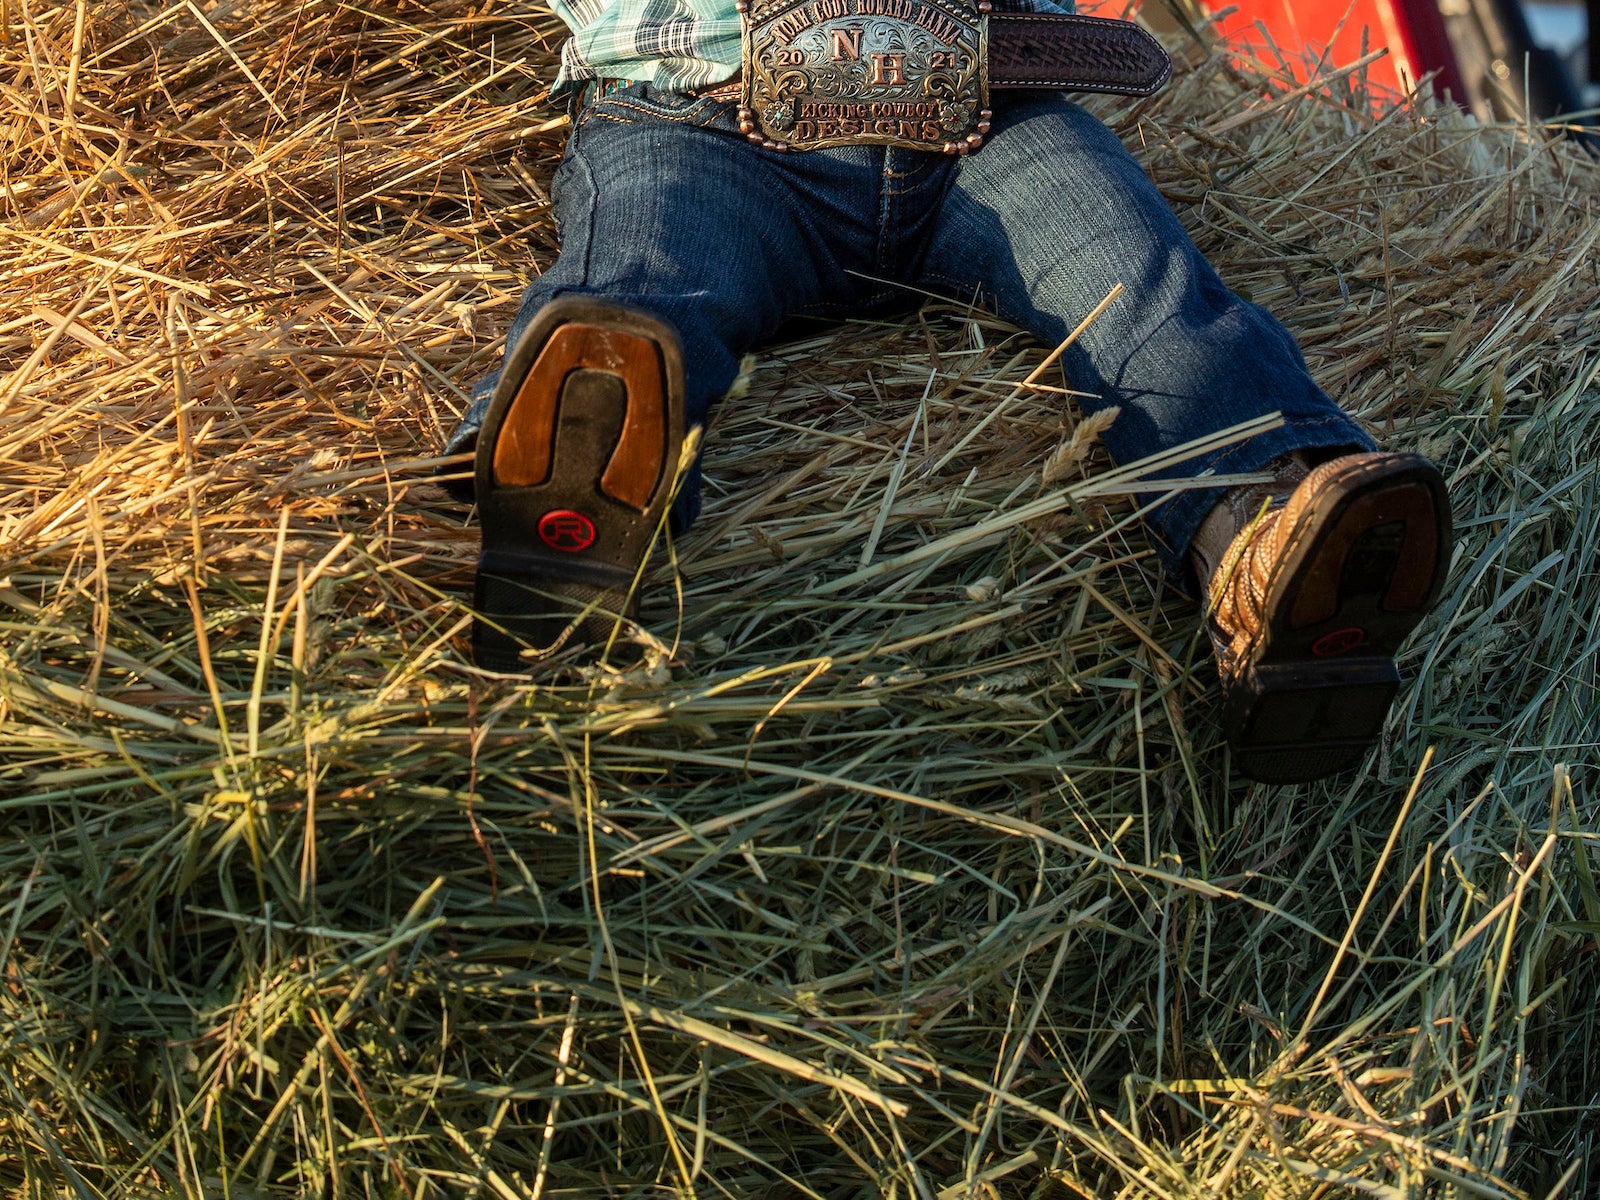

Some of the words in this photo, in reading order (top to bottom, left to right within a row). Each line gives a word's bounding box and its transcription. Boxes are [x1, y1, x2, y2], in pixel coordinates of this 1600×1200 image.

[772, 14, 812, 46] NOAH
[915, 5, 962, 46] HANNA
[831, 28, 863, 61] N
[778, 51, 803, 67] 20
[871, 52, 907, 85] H
[931, 52, 956, 68] 21
[800, 103, 868, 120] KICKING
[870, 102, 936, 120] COWBOY
[795, 119, 941, 141] DESIGNS
